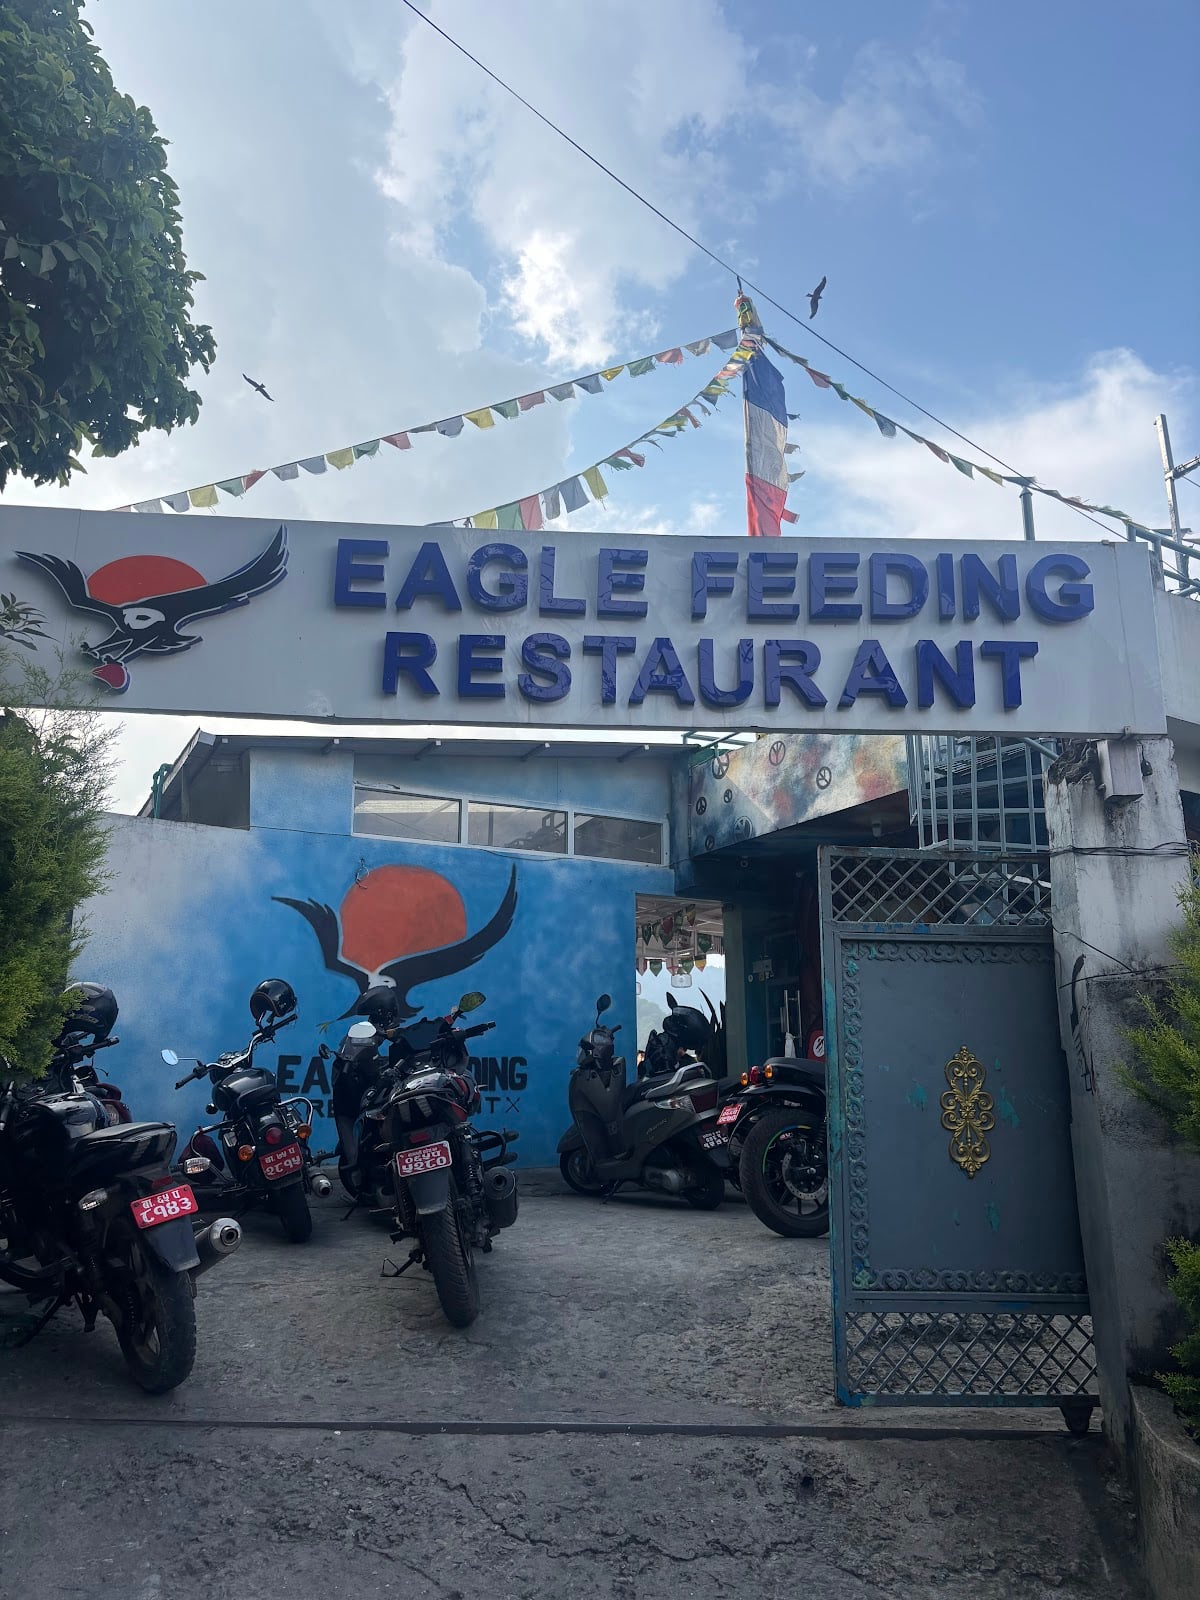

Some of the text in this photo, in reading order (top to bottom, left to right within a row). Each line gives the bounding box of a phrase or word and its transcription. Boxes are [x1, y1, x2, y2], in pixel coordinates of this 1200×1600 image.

[334, 538, 1094, 623] EAGLE FEEDING
[382, 631, 1038, 710] RESTAURANT
[139, 1197, 192, 1223] ८१४३
[171, 1189, 181, 1199] प
